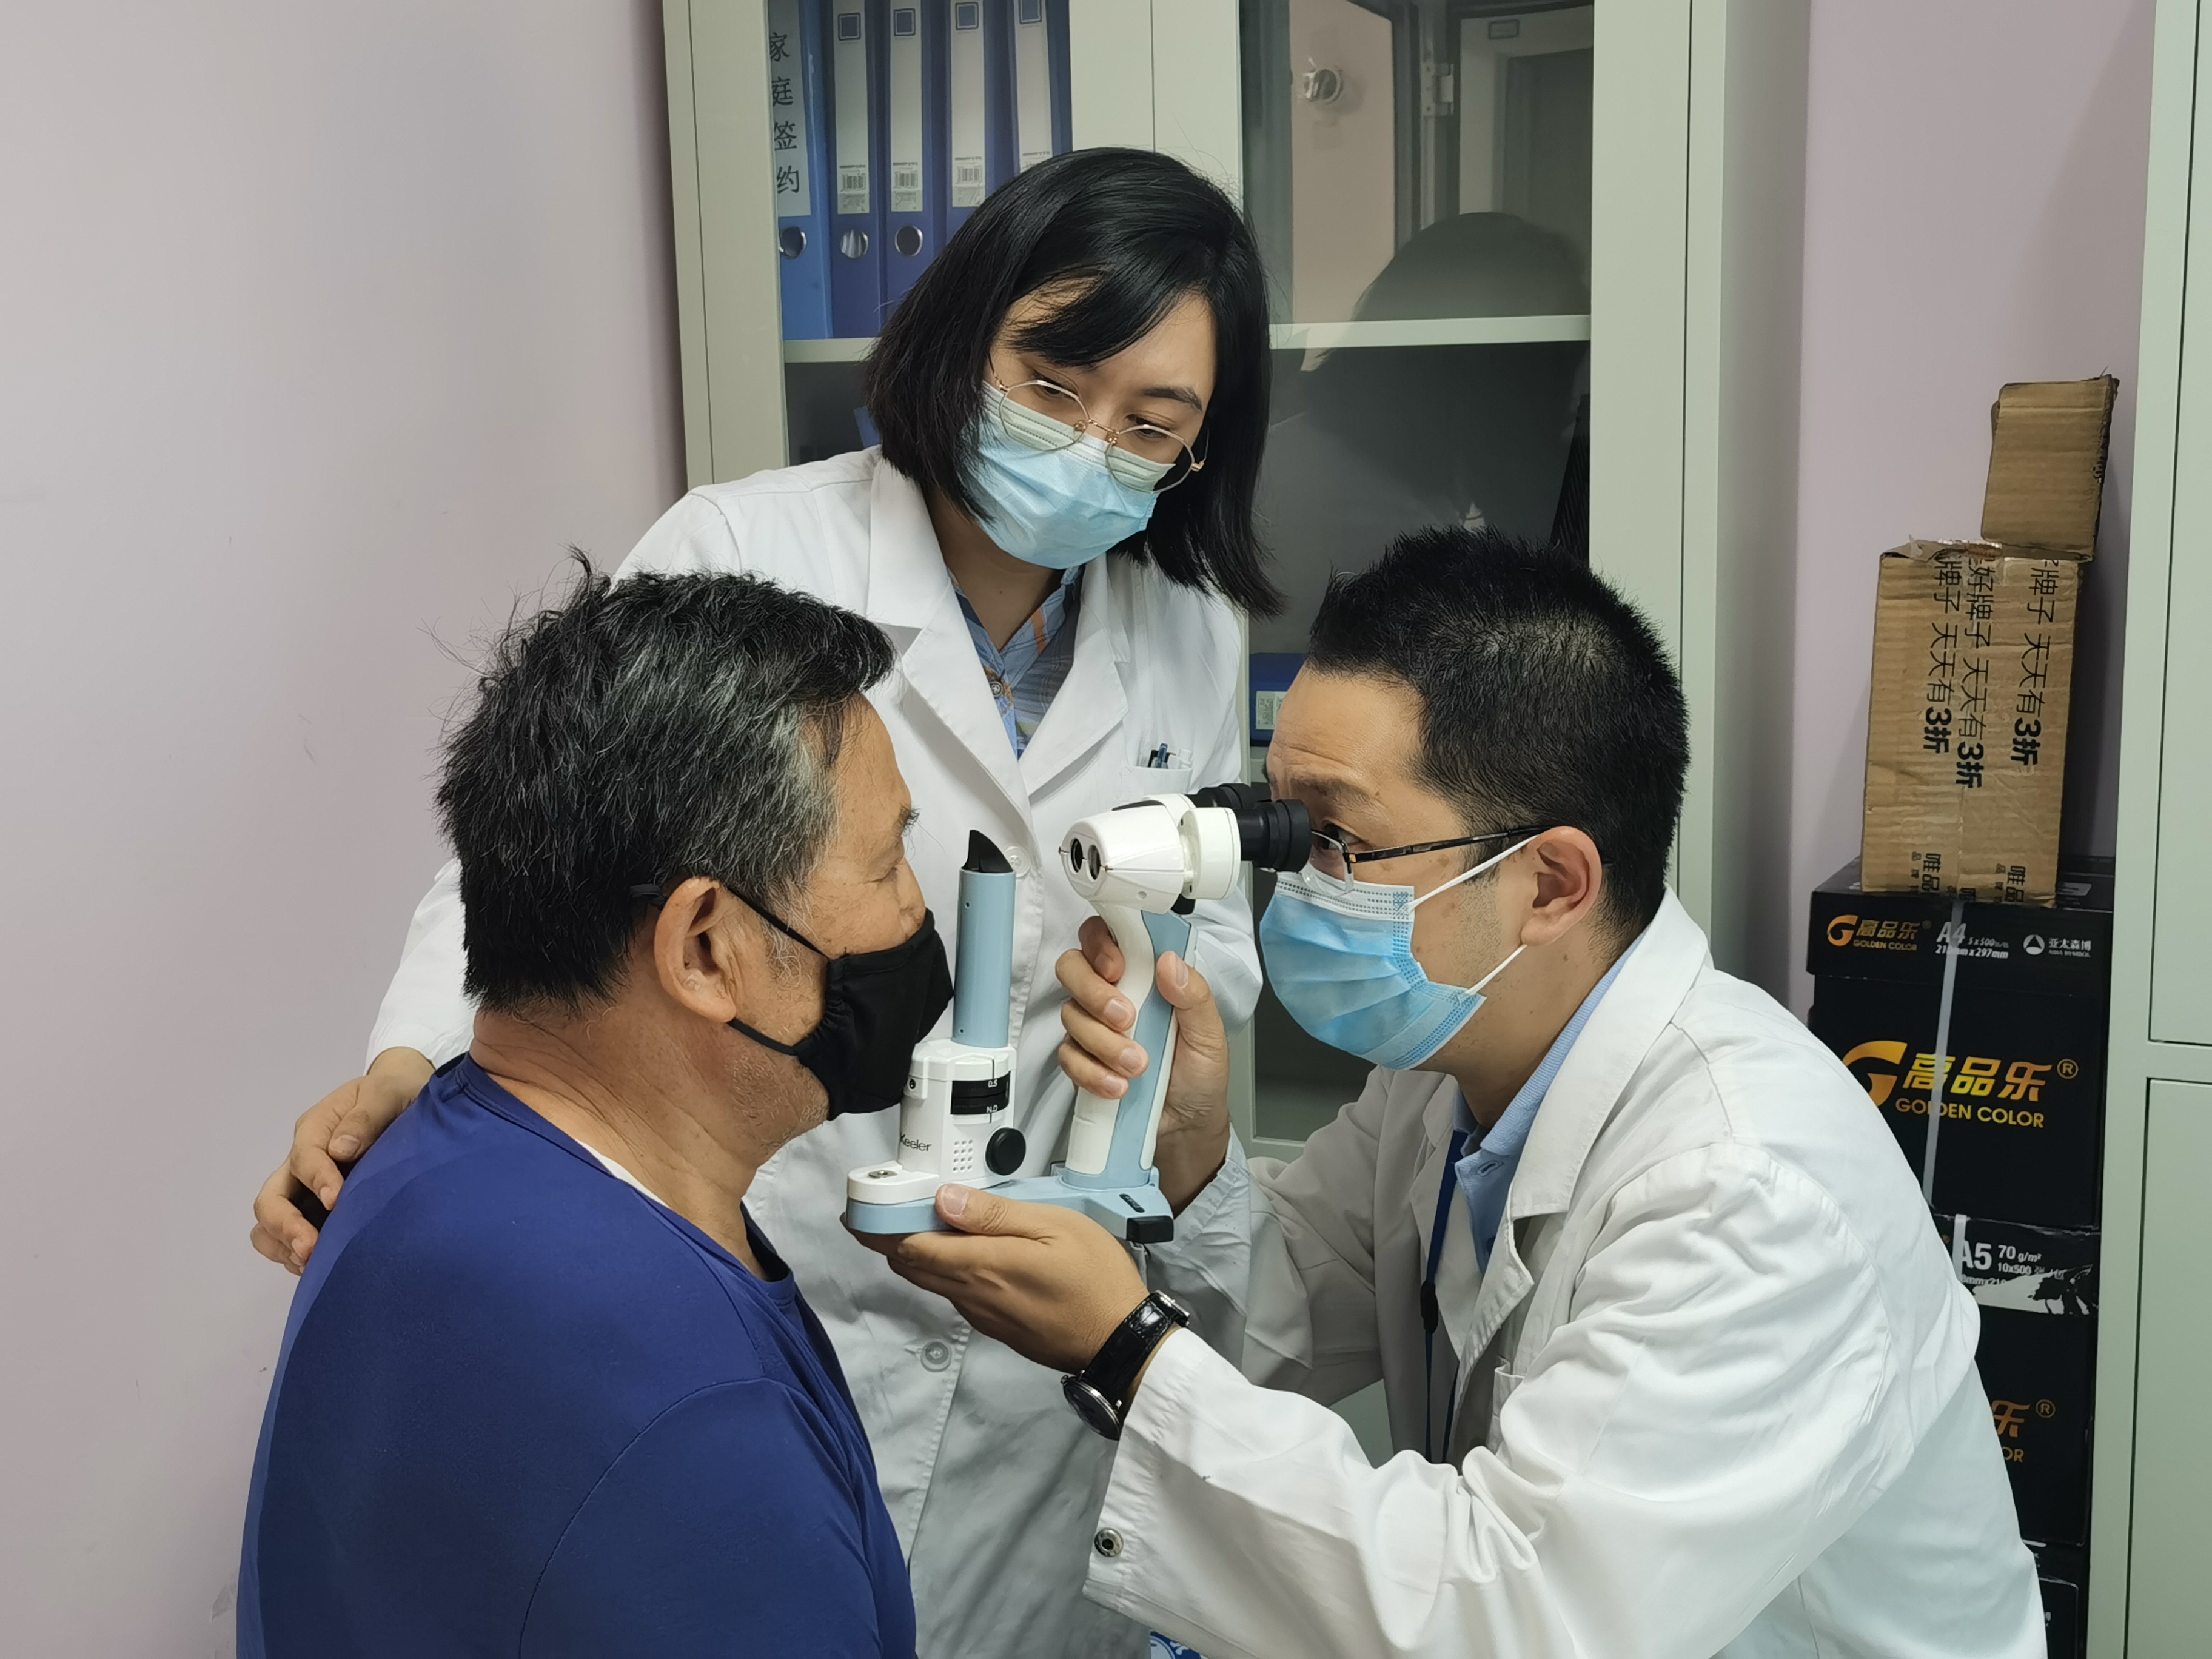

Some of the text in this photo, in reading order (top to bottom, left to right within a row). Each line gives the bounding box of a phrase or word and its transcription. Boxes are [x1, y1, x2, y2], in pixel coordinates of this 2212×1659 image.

[769, 32, 800, 194] 家庭签约
[2026, 560, 2059, 625] 牌子
[1856, 920, 1920, 939] 高品乐
[1936, 921, 1966, 944] A4
[1853, 940, 1917, 951] GOLDEN COLOR
[1902, 1053, 2053, 1102] 高品乐
[1977, 1106, 2045, 1128] COLOR
[900, 1134, 933, 1151] Keeler
[1997, 1245, 2016, 1259] 70
[1997, 1262, 2032, 1275] 10x500
